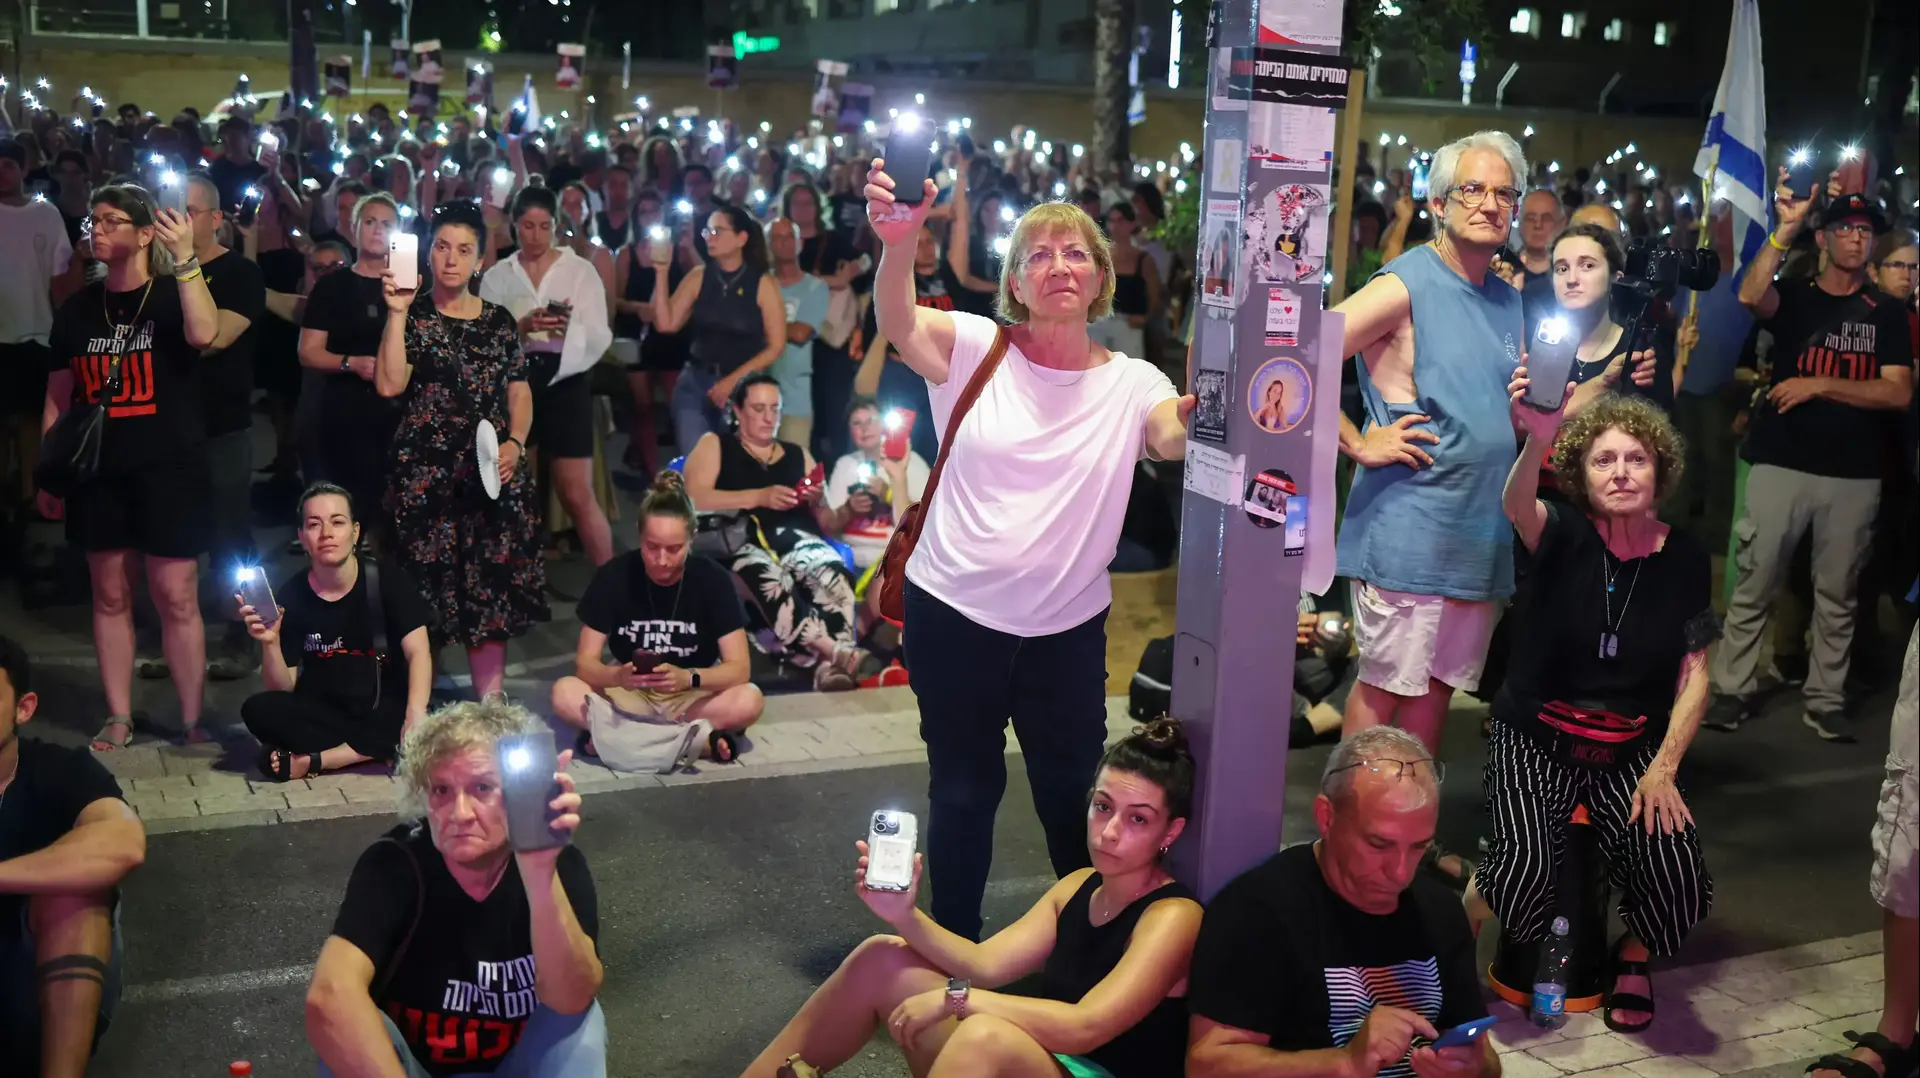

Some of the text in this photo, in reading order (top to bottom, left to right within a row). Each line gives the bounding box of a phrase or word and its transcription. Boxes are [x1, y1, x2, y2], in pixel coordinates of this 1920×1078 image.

[1255, 60, 1347, 84] מחזירים אותם הביתה
[128, 334, 153, 351] אות
[630, 620, 697, 635] אחרת
[643, 632, 672, 648] אין
[442, 979, 500, 1017] הביתה
